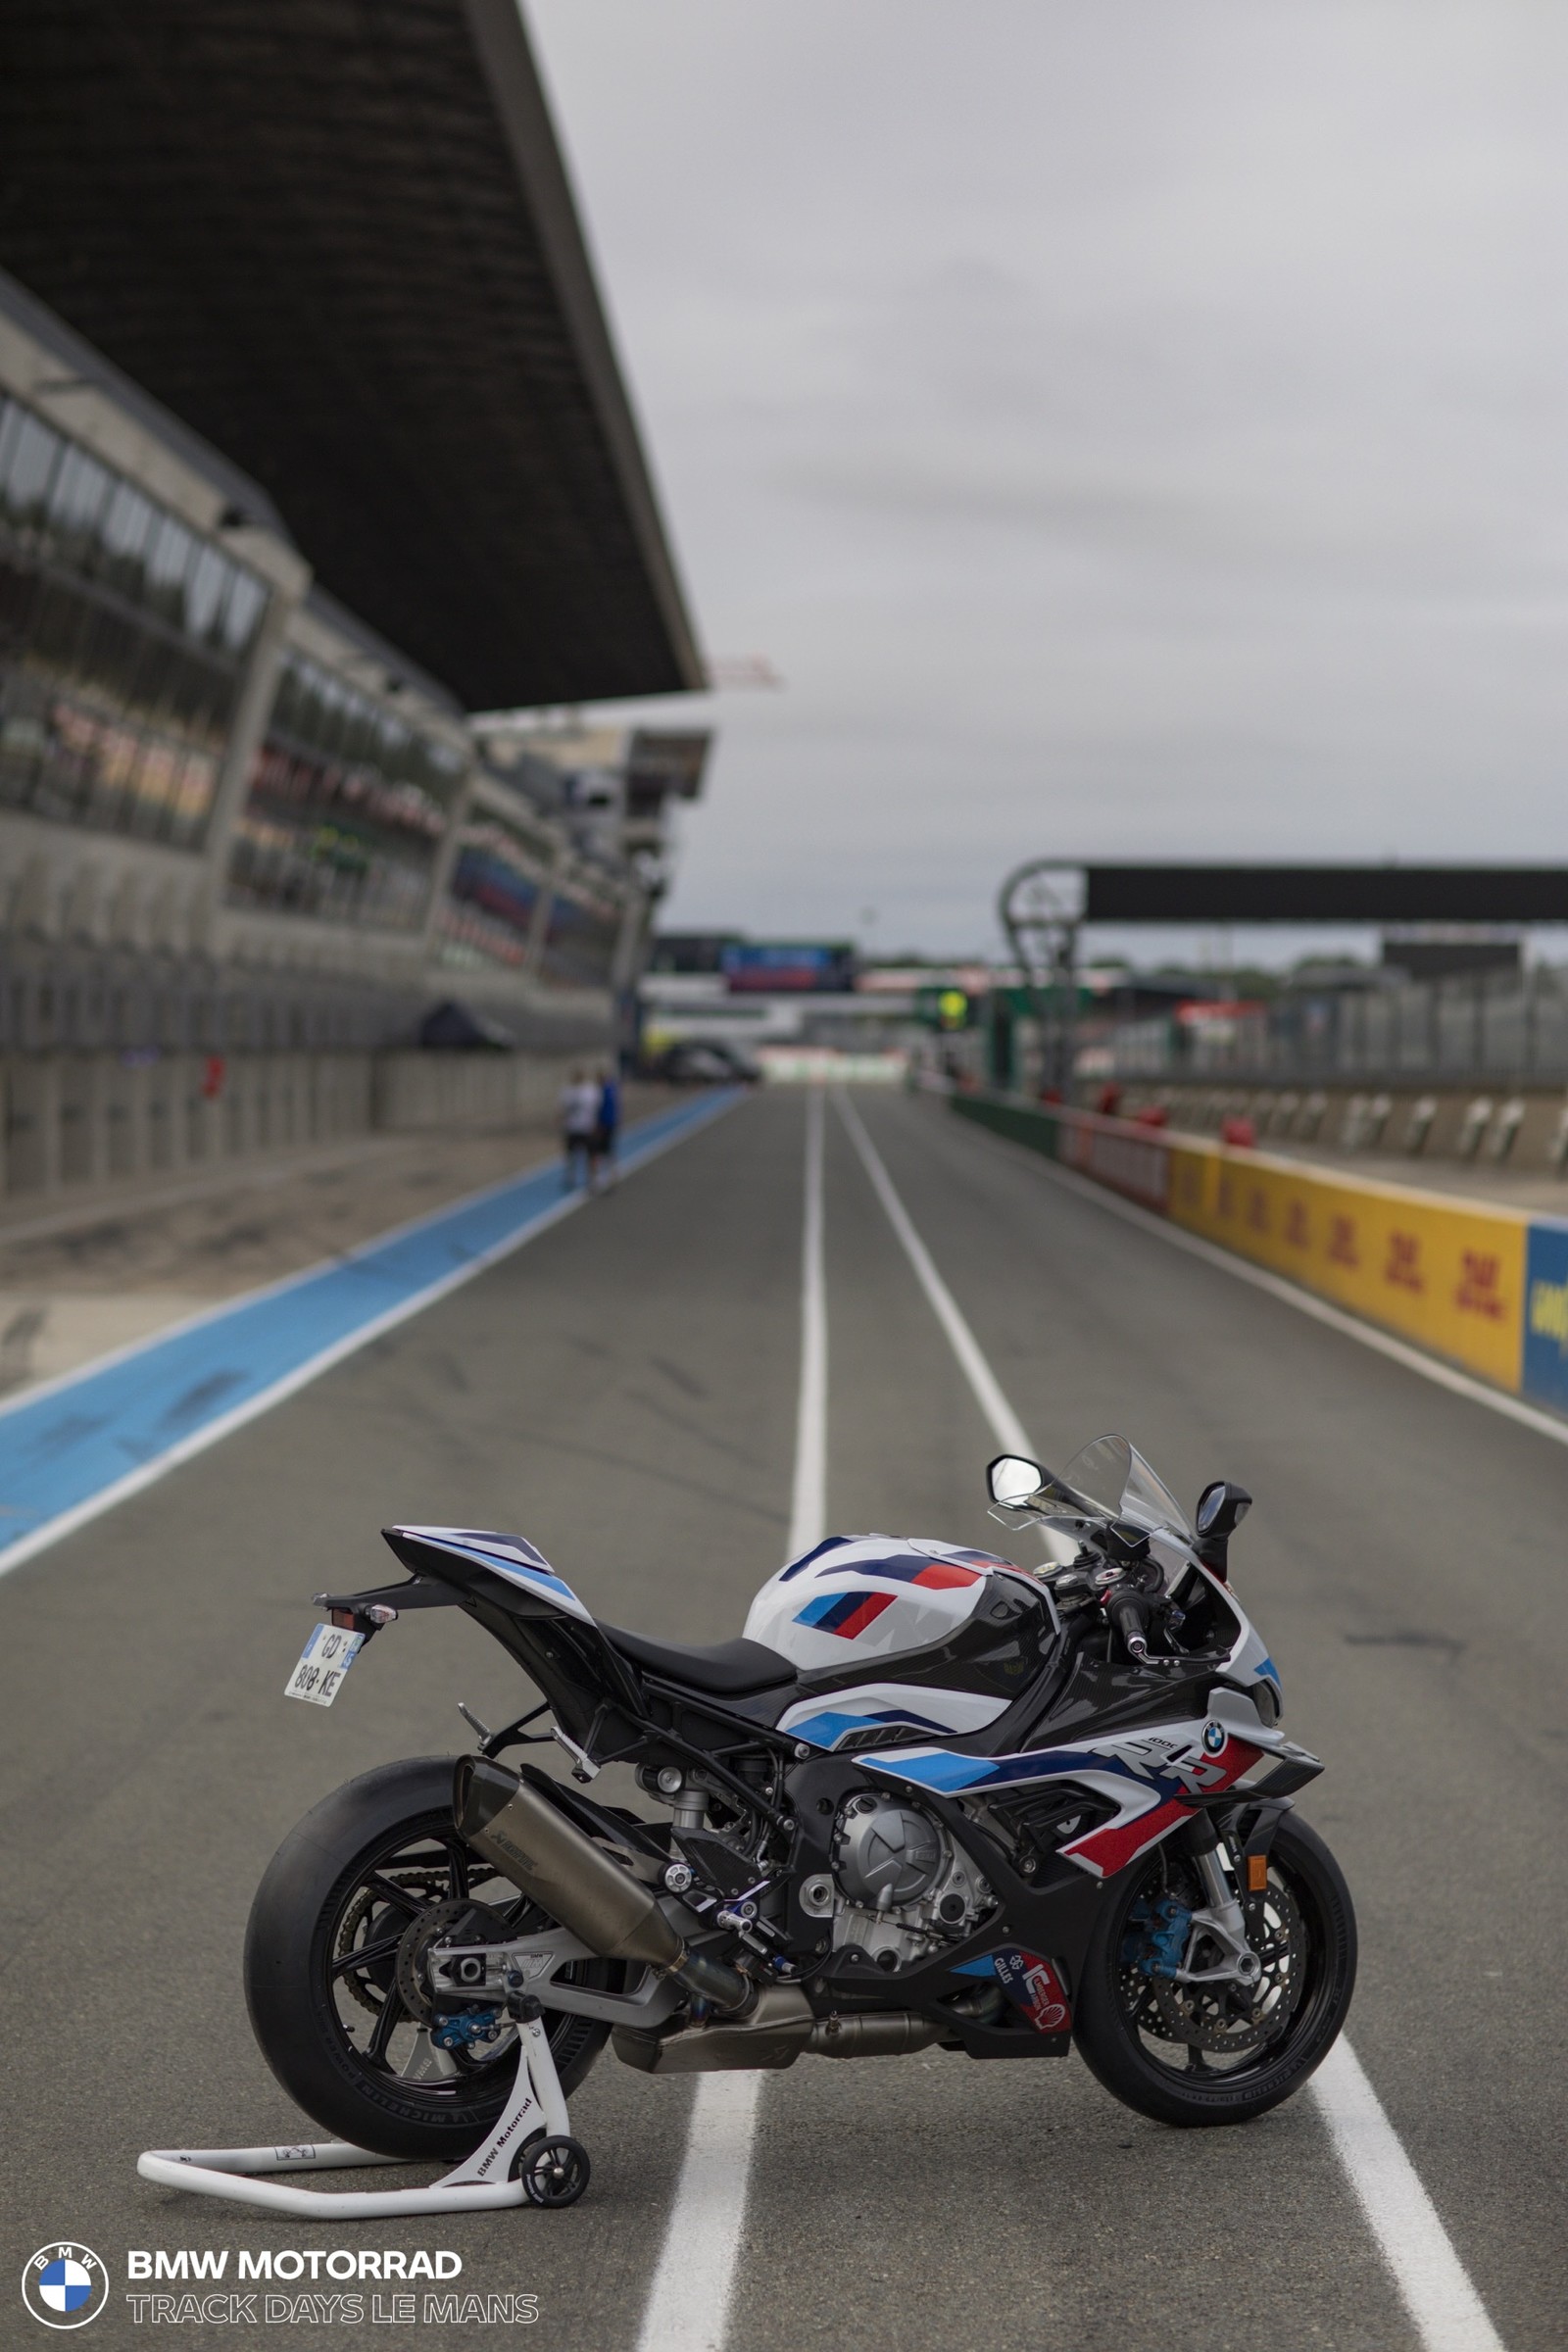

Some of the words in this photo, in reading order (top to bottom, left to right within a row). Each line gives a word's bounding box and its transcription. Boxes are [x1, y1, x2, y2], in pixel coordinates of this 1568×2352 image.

[320, 1634, 342, 1659] GD
[994, 1957, 1014, 1984] GILLES
[362, 2083, 446, 2124] MICHELIN
[476, 2148, 499, 2177] BMW
[496, 2098, 532, 2147] Motorrad
